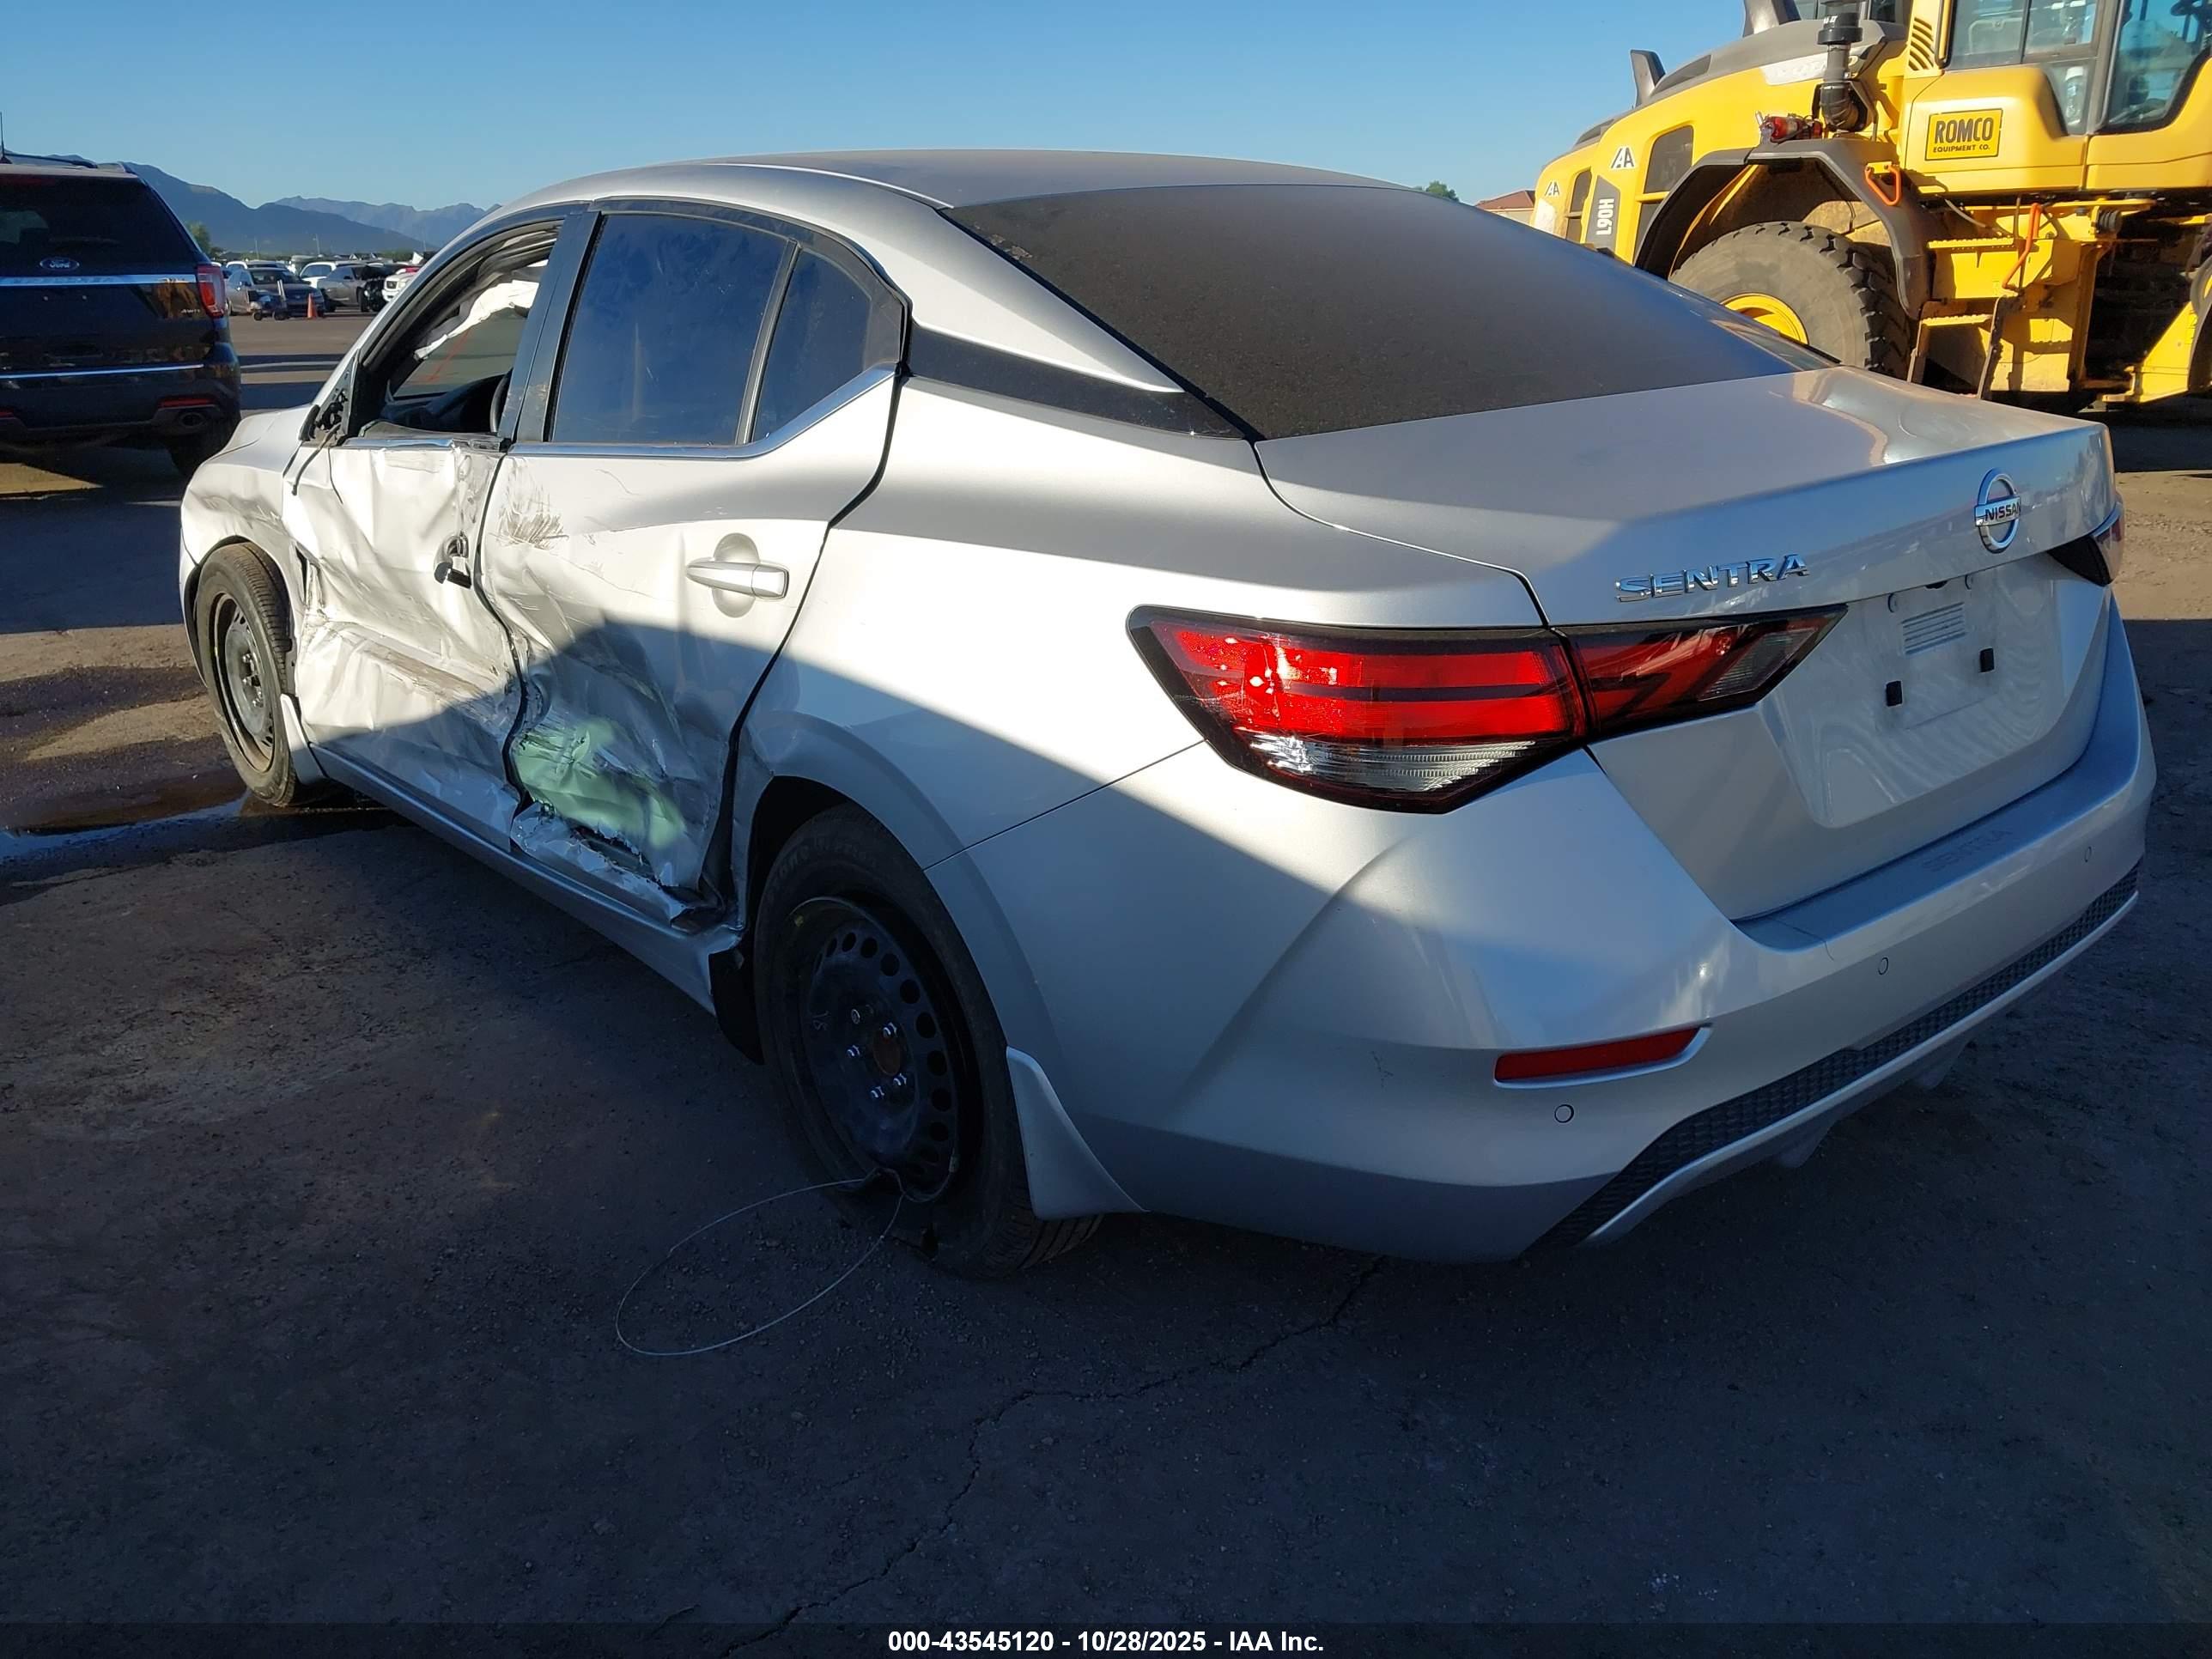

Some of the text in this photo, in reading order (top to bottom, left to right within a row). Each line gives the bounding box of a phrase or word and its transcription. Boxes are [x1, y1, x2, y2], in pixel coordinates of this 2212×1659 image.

[1934, 117, 1994, 144] ROMCO
[1932, 144, 1977, 153] EQUIPMENT
[1595, 198, 1615, 235] L90H
[1984, 501, 2021, 521] NISSAN
[1614, 553, 1810, 603] SENTRA
